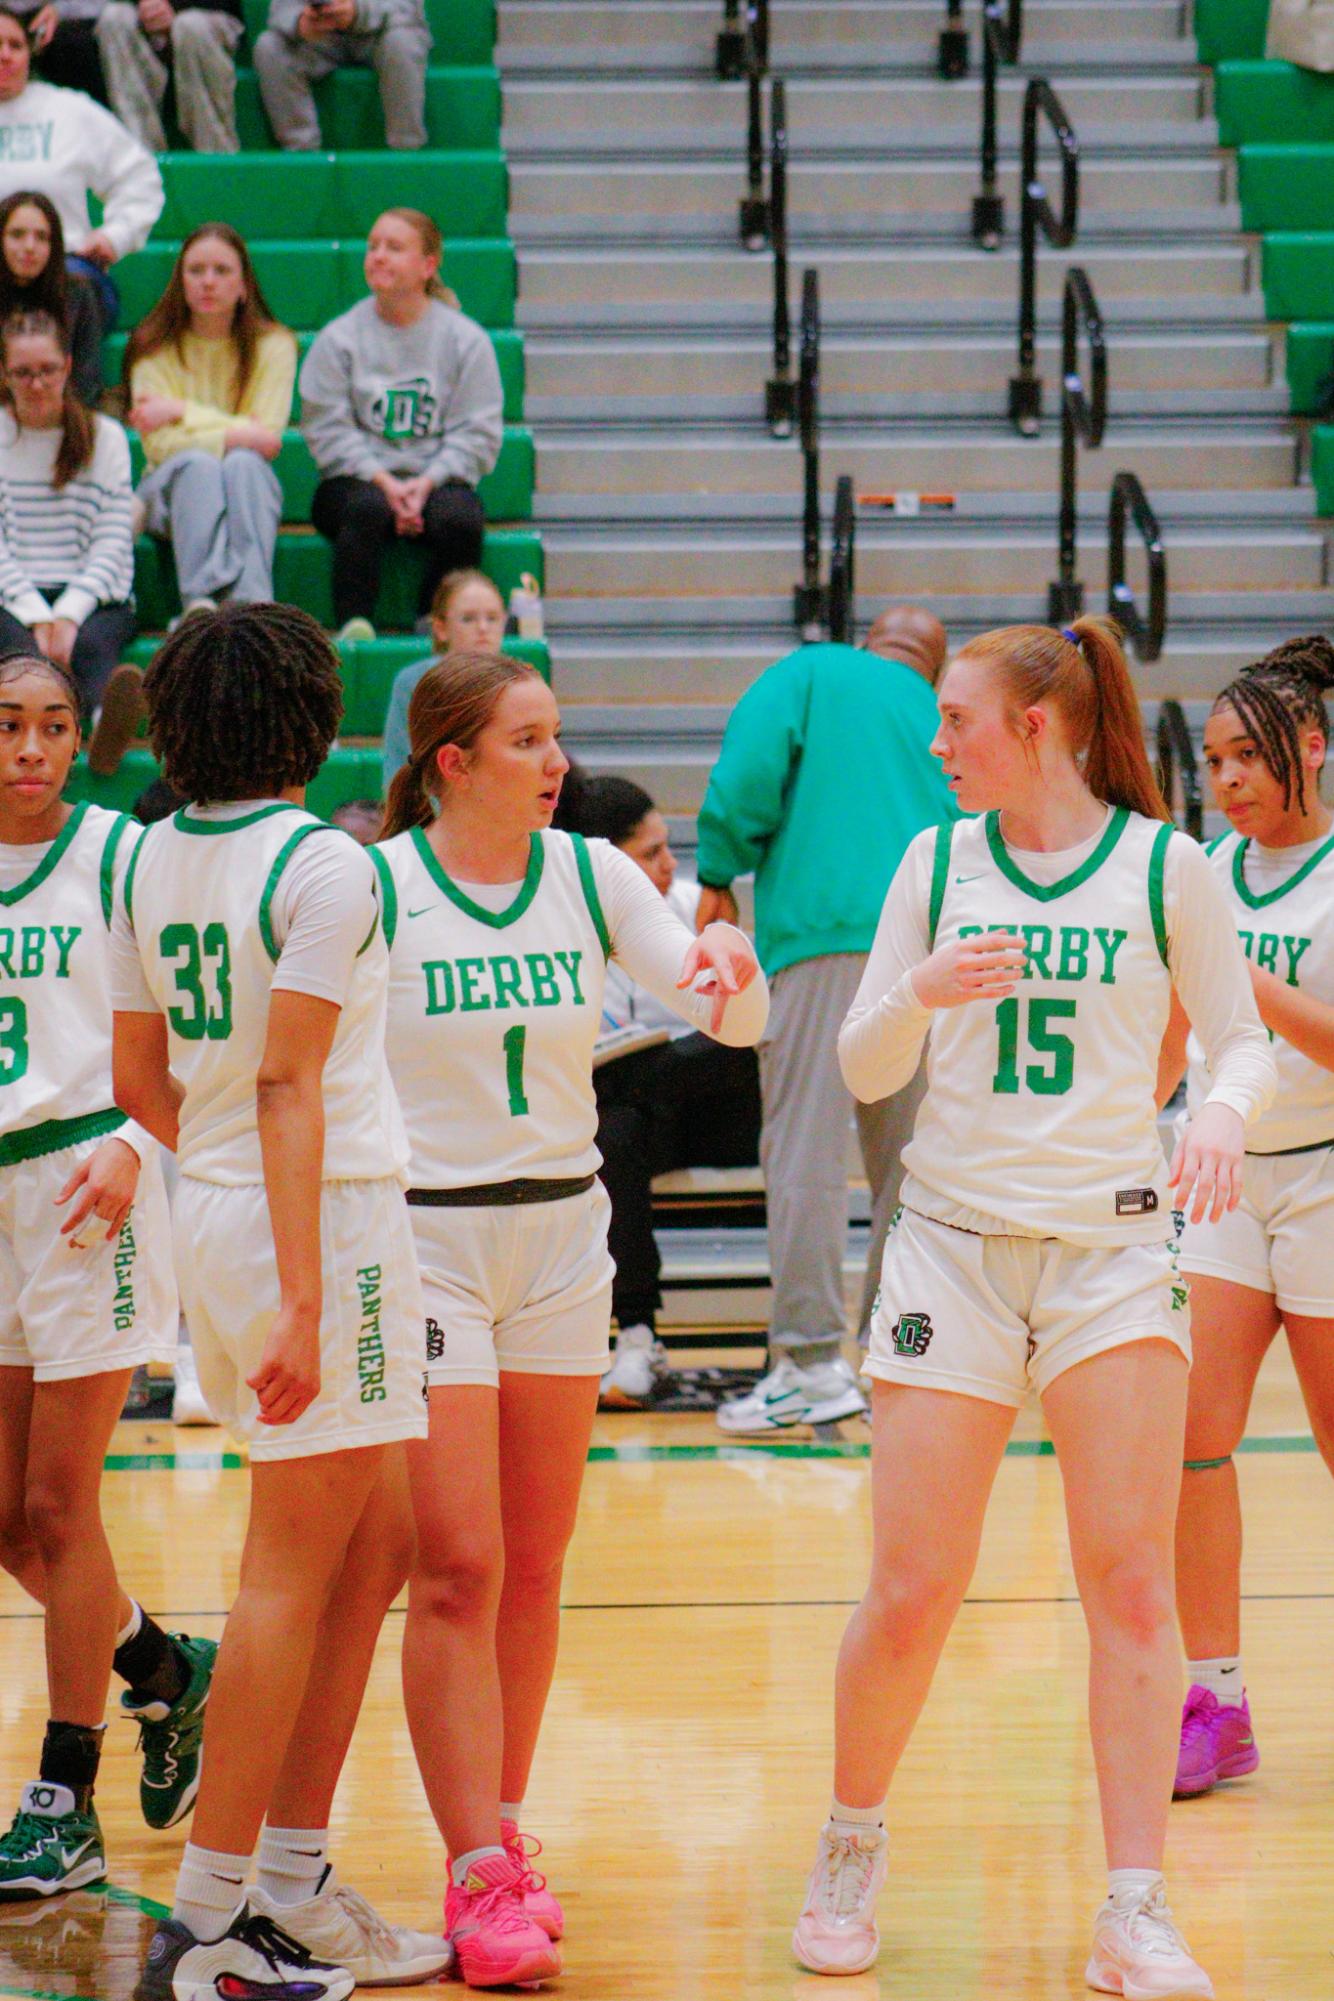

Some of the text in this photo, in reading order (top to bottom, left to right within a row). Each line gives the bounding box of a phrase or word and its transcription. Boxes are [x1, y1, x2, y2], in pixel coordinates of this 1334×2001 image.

[0, 926, 82, 978] RBY
[159, 922, 233, 1040] 33
[421, 951, 586, 1016] DERBY
[503, 1025, 529, 1117] 1
[993, 997, 1076, 1096] 15
[356, 1264, 387, 1404] PANTHERS
